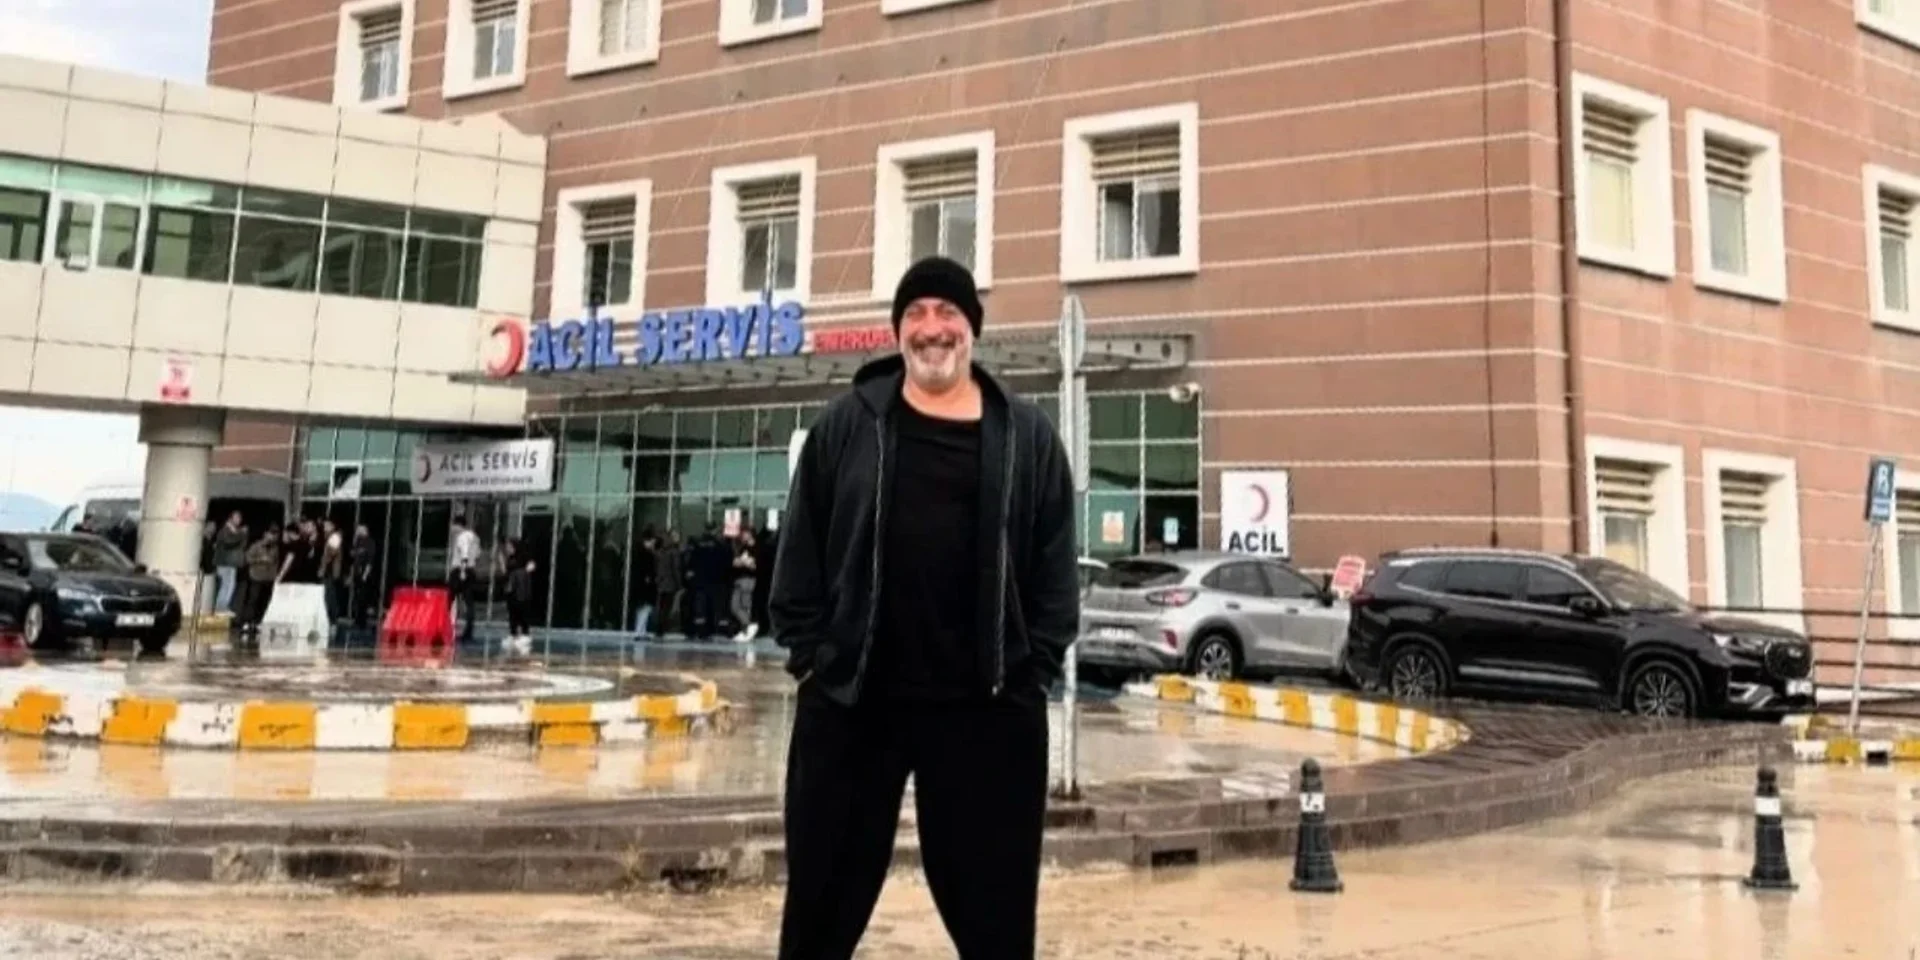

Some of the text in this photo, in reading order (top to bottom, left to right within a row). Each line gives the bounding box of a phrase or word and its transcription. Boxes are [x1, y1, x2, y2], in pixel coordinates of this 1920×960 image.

[634, 293, 804, 365] SERVİS
[482, 447, 538, 470] SERVİS
[1228, 526, 1284, 553] ACİL
